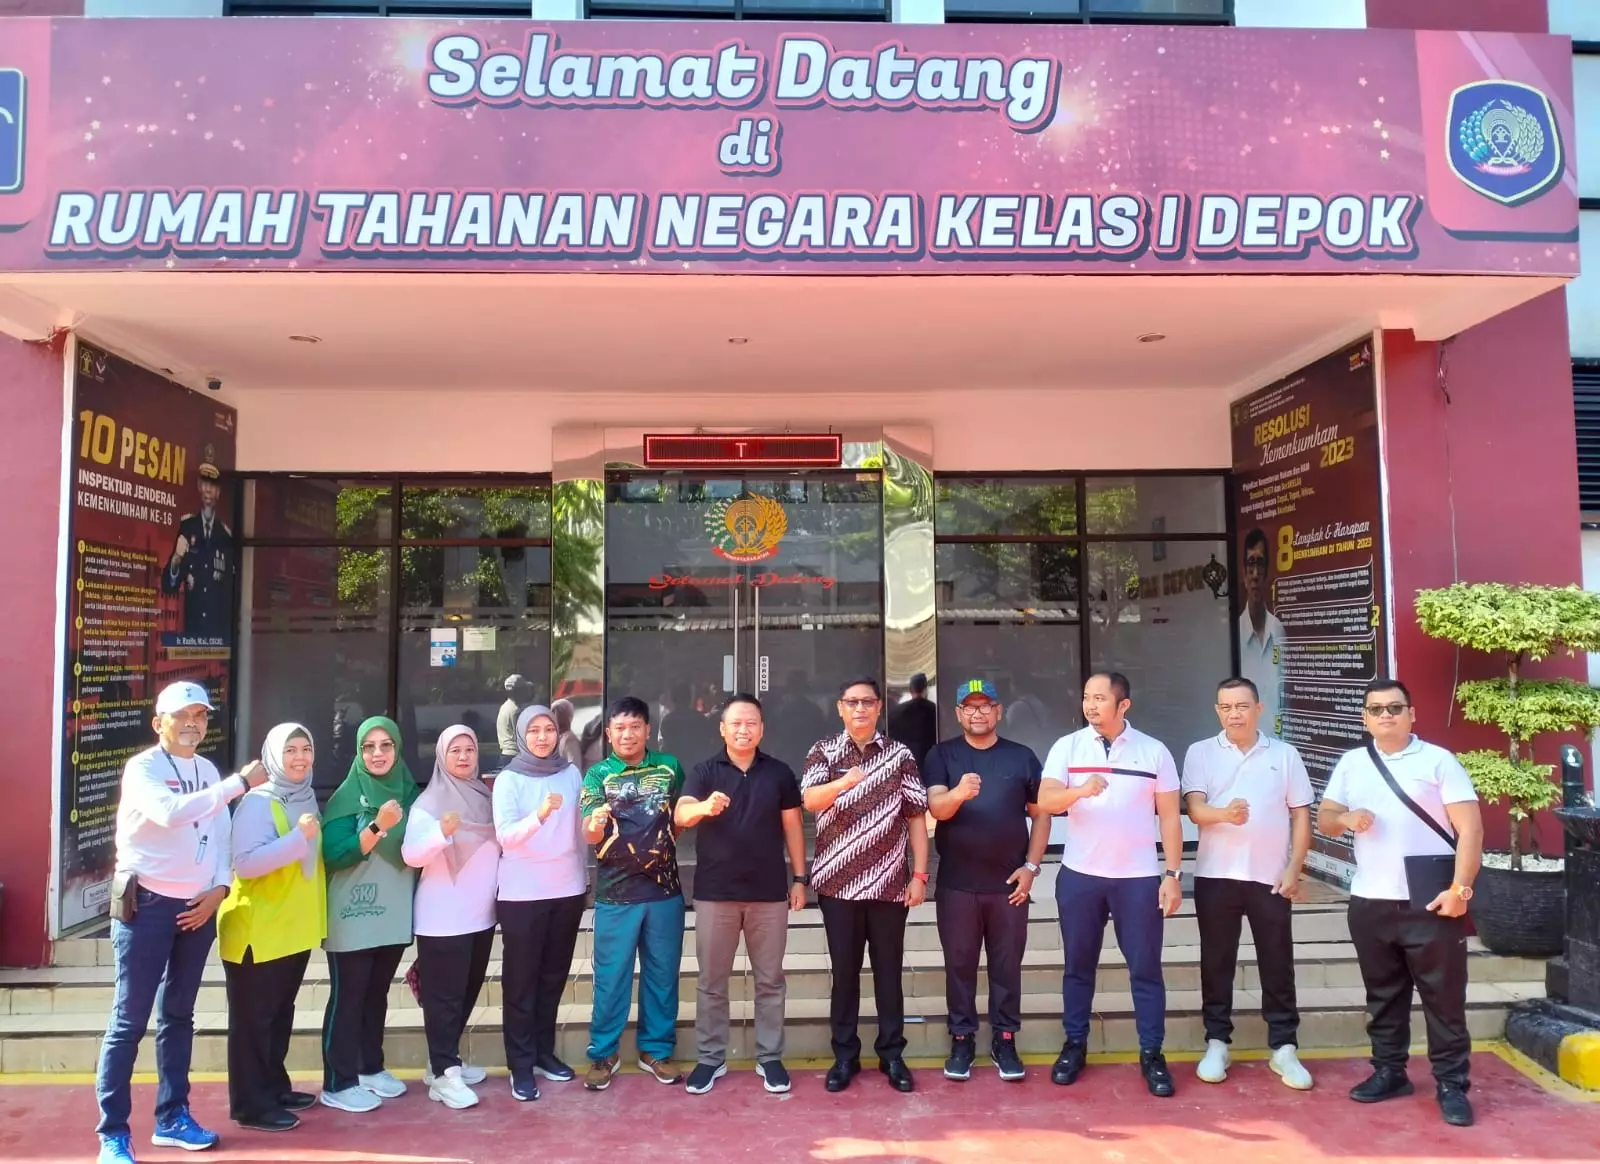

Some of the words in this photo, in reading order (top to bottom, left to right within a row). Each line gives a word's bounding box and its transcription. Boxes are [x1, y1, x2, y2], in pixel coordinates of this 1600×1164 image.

[428, 33, 756, 98] Selamat
[778, 40, 1053, 122] Datang
[720, 120, 771, 164] di
[51, 193, 296, 244] RUMAH
[315, 194, 635, 245] TAHANAN
[655, 196, 912, 246] NEGARA
[935, 197, 1139, 246] KELAS
[1160, 197, 1178, 245] I
[1198, 197, 1409, 246] DEPOK
[1254, 404, 1310, 447] RESOLUSI
[80, 409, 115, 465] 10
[120, 427, 186, 486] PESAN
[736, 443, 748, 458] T
[1260, 424, 1339, 466] Kemenkumham
[1320, 436, 1354, 468] 2023
[79, 469, 132, 497] INSPEKTUR
[134, 485, 176, 507] JENDERAL
[78, 492, 148, 521] KEMENKUMHAM
[150, 509, 172, 526] KE-16
[1277, 525, 1294, 572] 8
[1293, 526, 1324, 547] Langkah
[1325, 524, 1332, 539] &
[1334, 522, 1370, 539] Harapan
[1329, 544, 1334, 553] DI
[1336, 540, 1355, 552] TAHUN
[1357, 537, 1372, 549] 2023
[649, 574, 744, 589] Selamat
[751, 572, 837, 589] Datang
[1371, 606, 1380, 626] 2
[350, 883, 377, 905] SKJ
